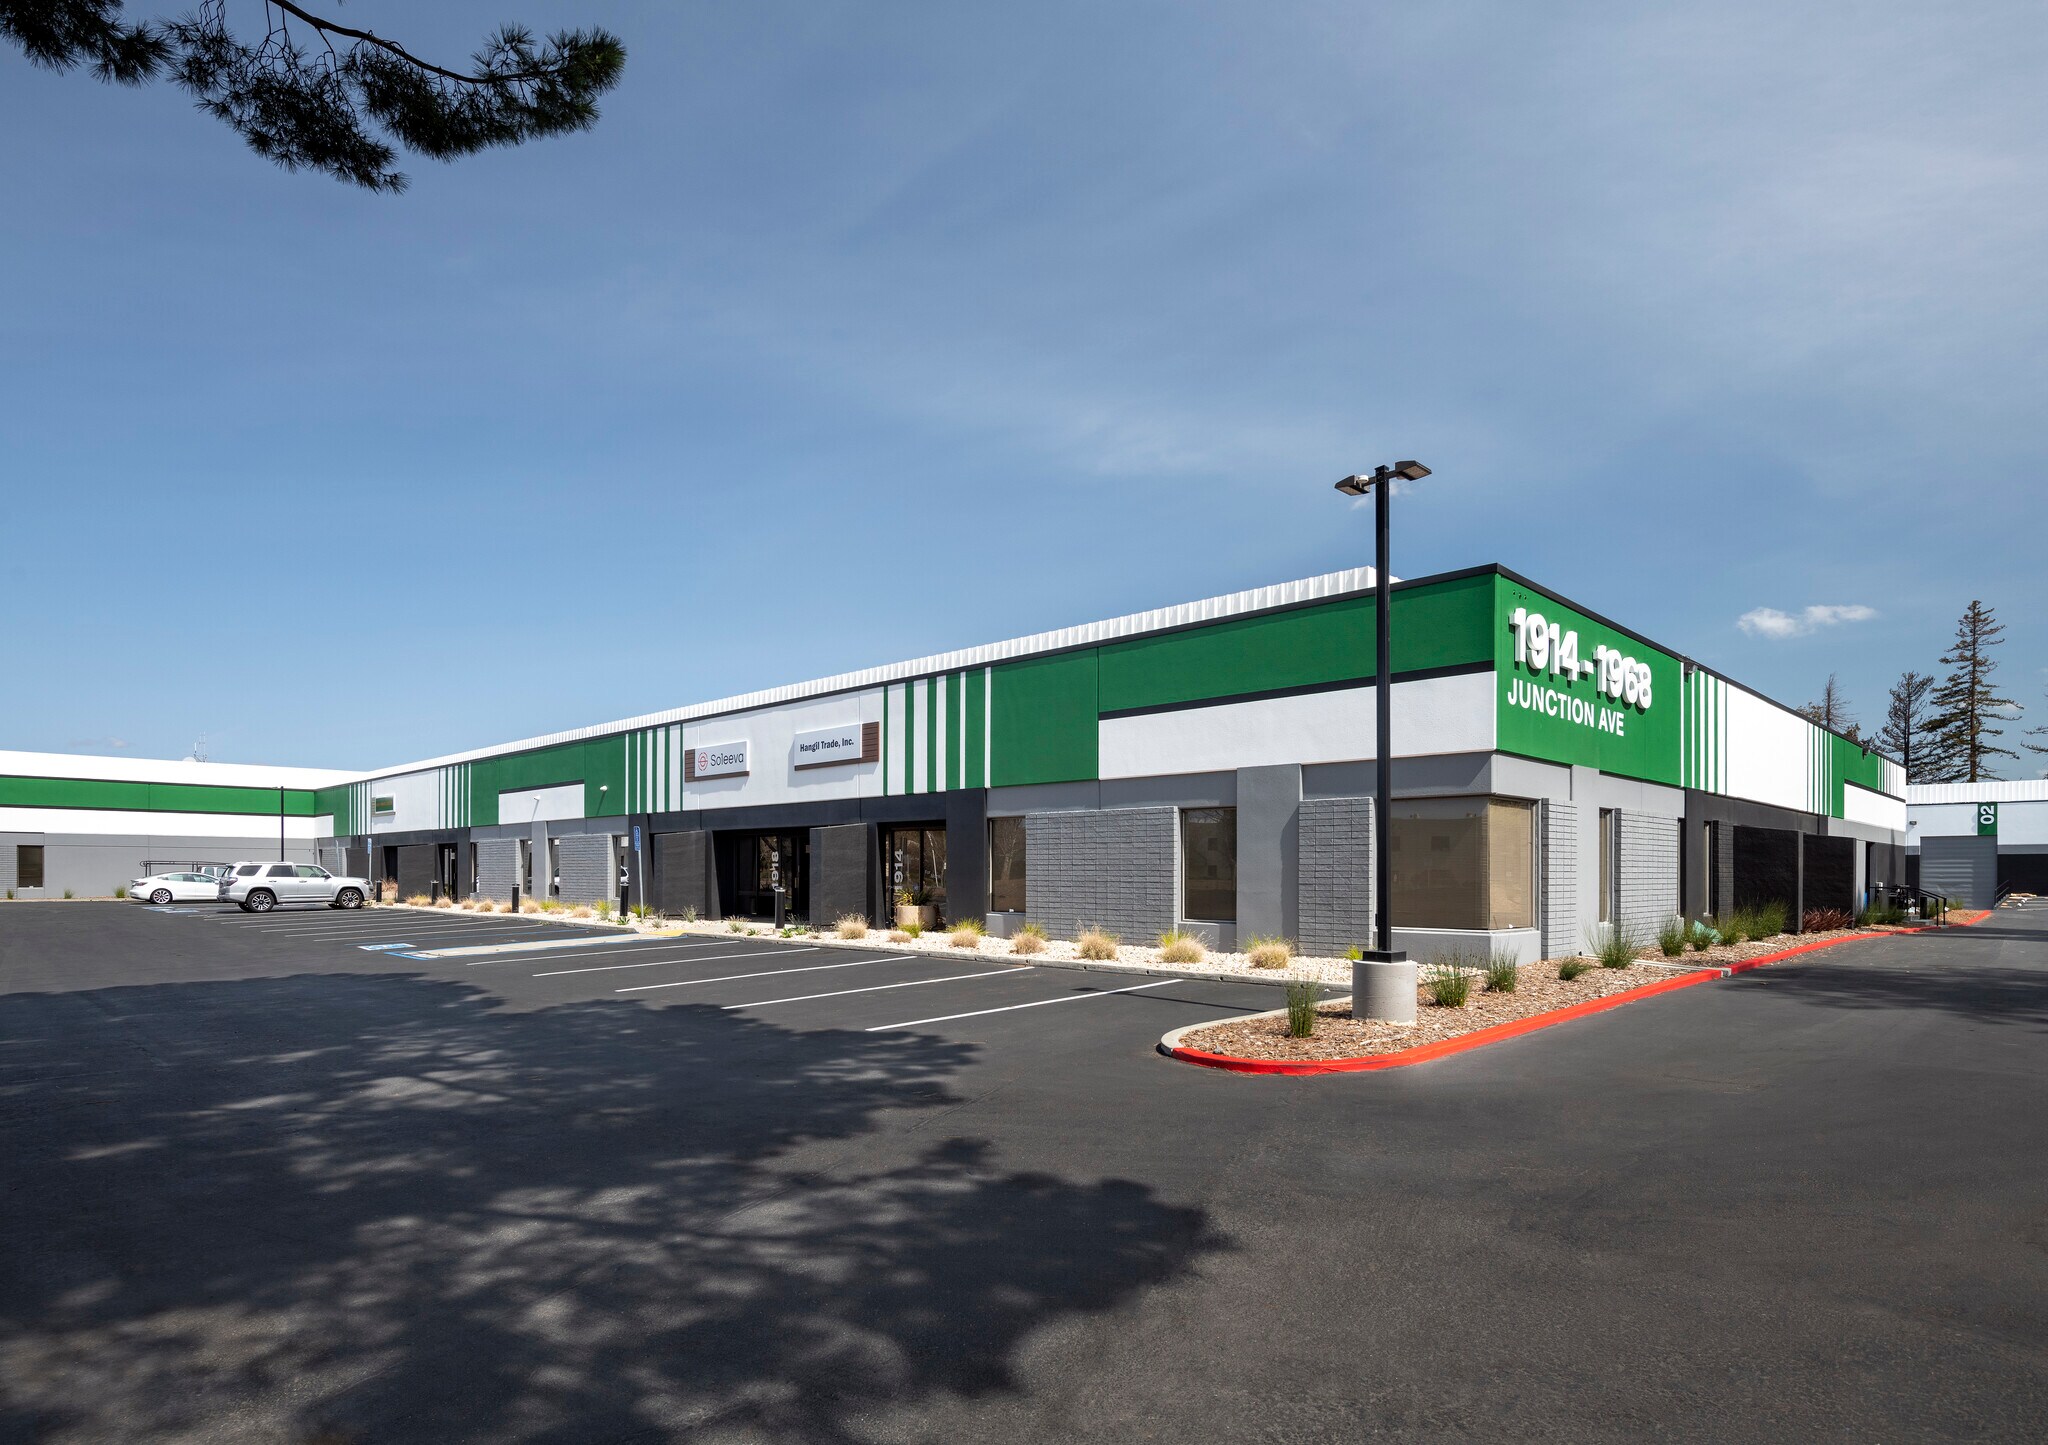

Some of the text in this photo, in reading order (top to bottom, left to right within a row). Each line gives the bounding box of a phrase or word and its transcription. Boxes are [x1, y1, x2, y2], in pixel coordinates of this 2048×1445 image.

[1508, 607, 1652, 709] 1914-1968
[1507, 678, 1625, 737] JUNCTION AVE
[710, 752, 744, 767] Soleeva
[799, 737, 854, 752] Hangil Trade, Inc.
[1980, 805, 1995, 825] 02
[894, 849, 904, 893] 1914
